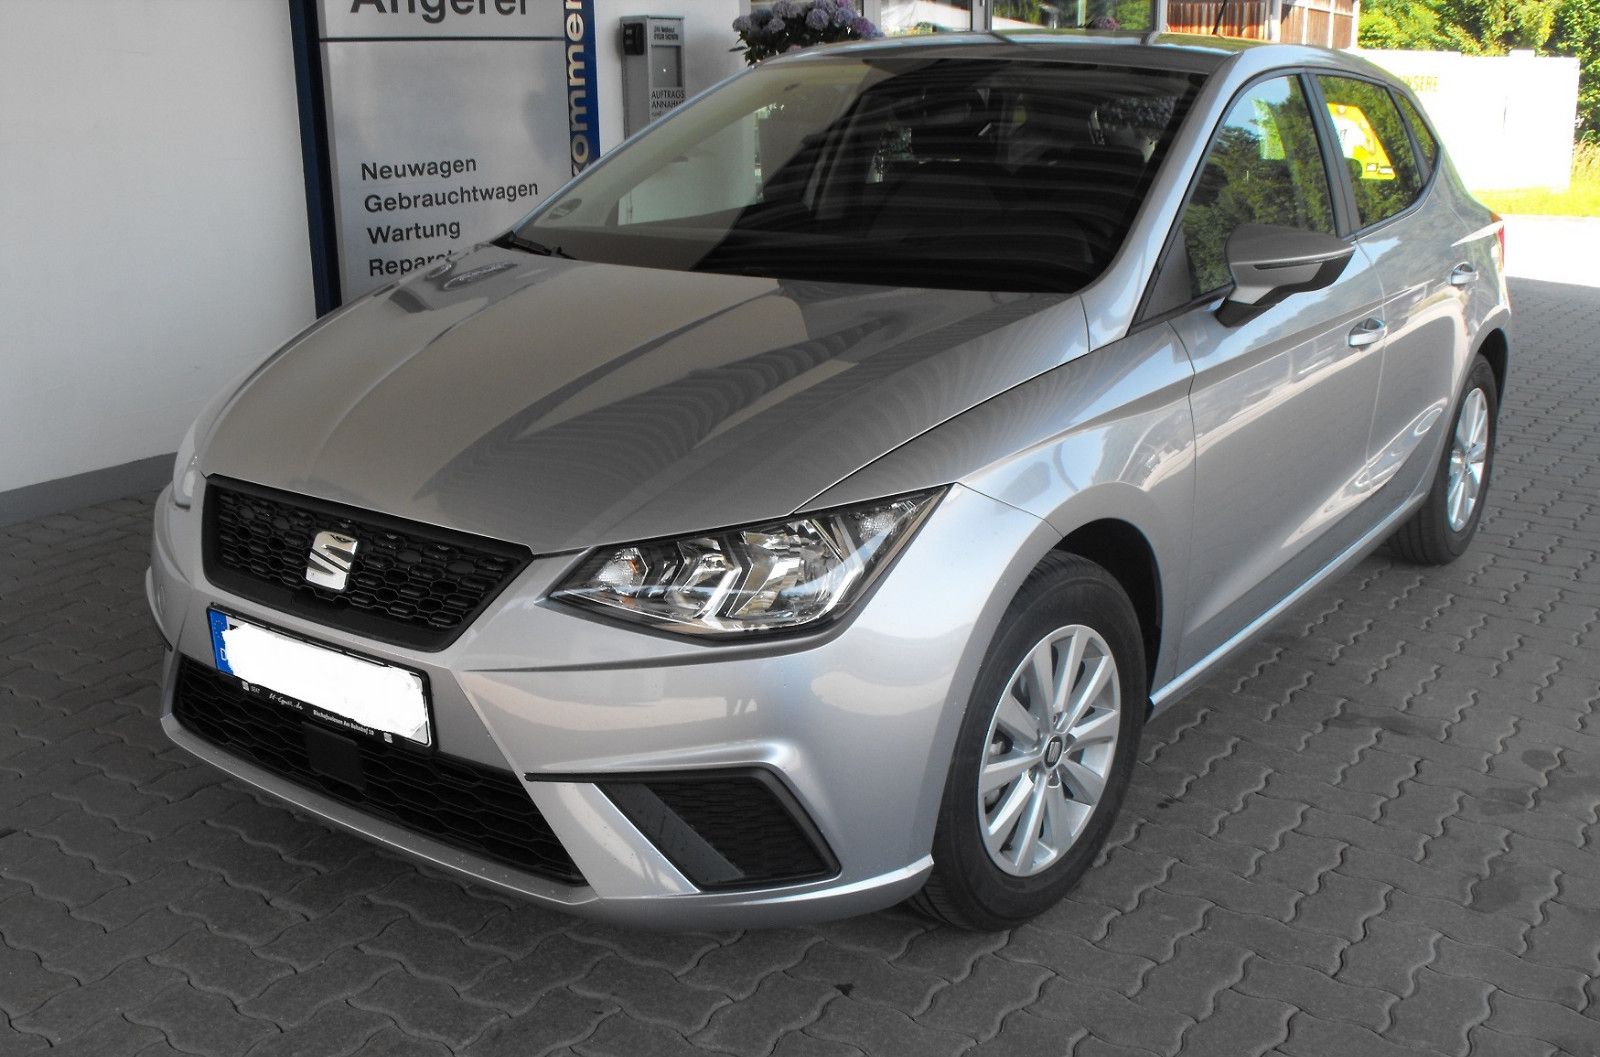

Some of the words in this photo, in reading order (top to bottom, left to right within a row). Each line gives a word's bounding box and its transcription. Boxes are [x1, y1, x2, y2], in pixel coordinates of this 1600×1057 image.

[361, 158, 477, 181] Neuwagen
[364, 182, 539, 213] Gebrauchtwagen
[366, 221, 461, 245] Wartung
[368, 250, 452, 277] Repar
